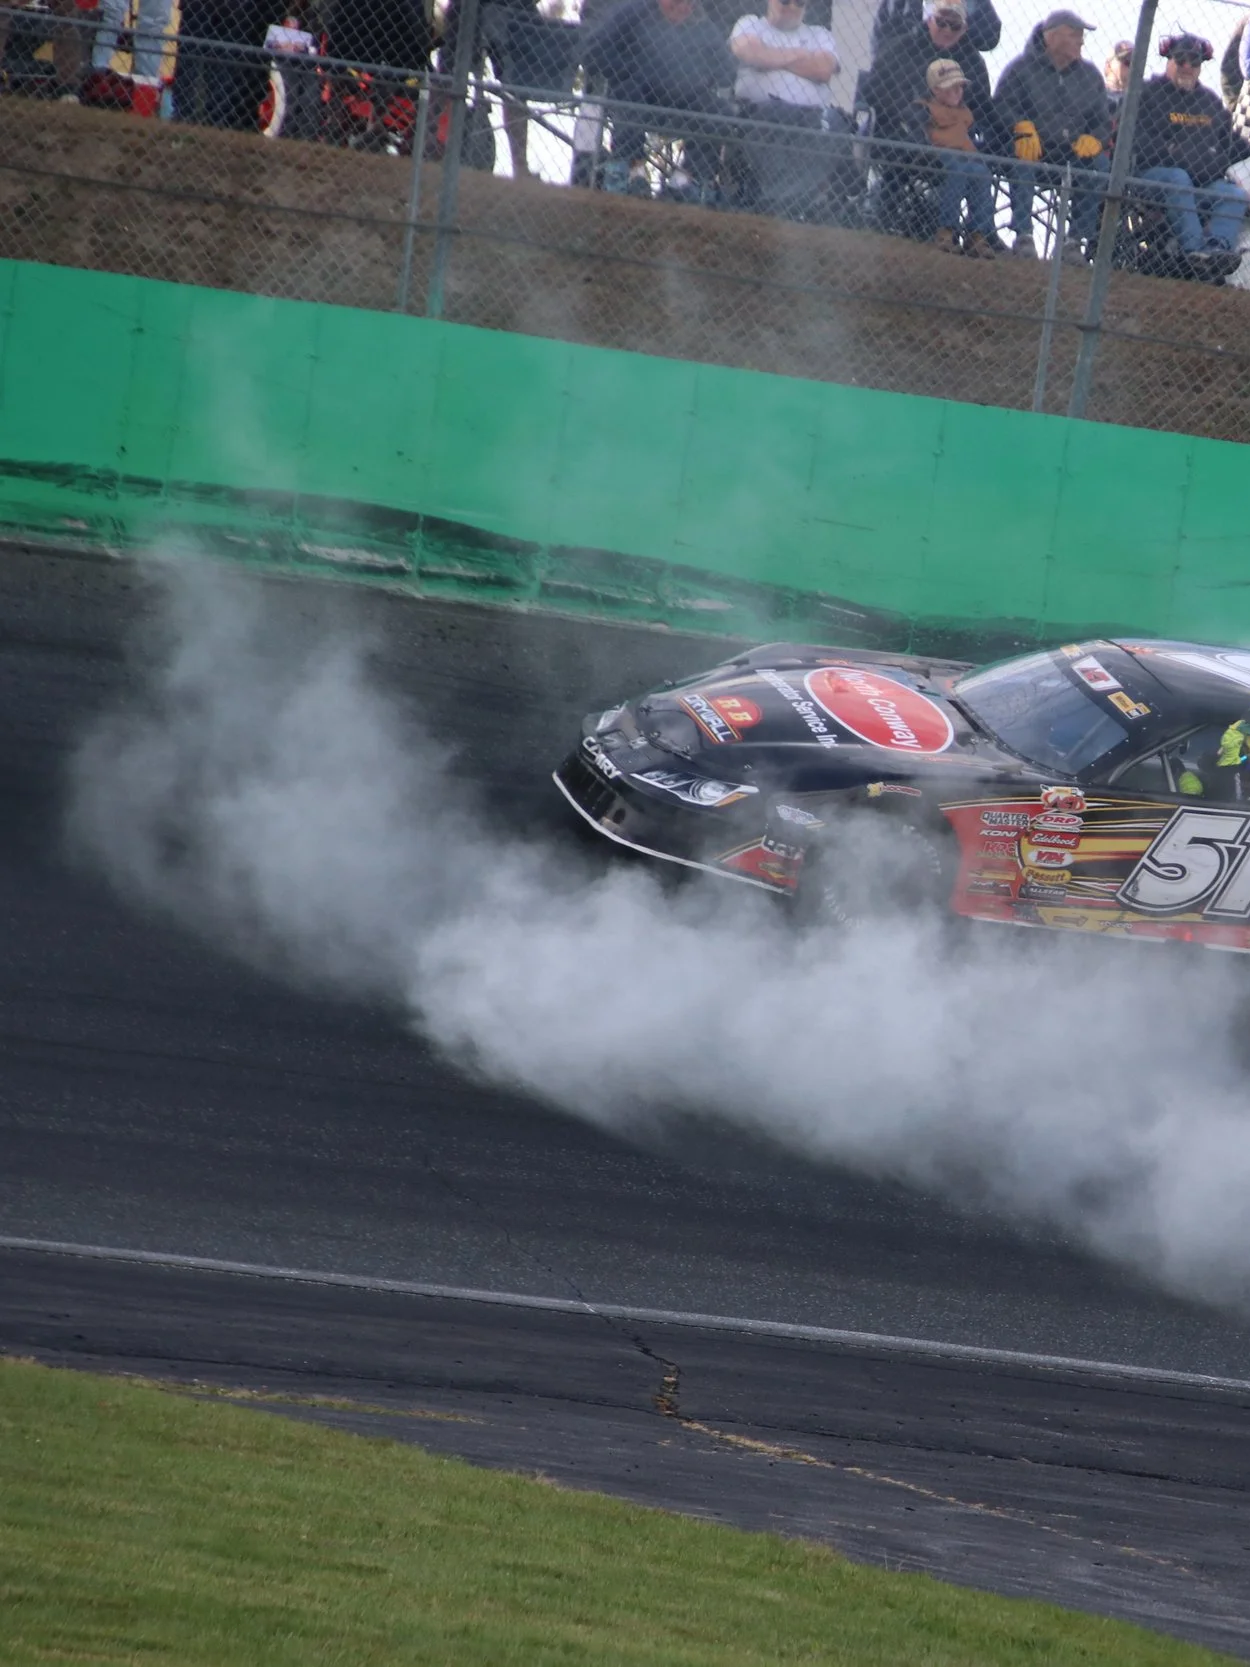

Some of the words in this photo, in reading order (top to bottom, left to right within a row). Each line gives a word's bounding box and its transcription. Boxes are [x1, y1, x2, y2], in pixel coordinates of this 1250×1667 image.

[684, 694, 731, 742] DRYWALL
[791, 701, 828, 733] Service
[866, 698, 921, 749] Conway
[582, 736, 622, 779] CAMRY
[982, 811, 1029, 822] QUARTER
[988, 818, 1029, 827] MASTER
[1042, 815, 1077, 823] DRP
[980, 829, 1018, 838] KONI
[1031, 833, 1077, 847] Edelbrock
[1026, 868, 1066, 881] Bassett
